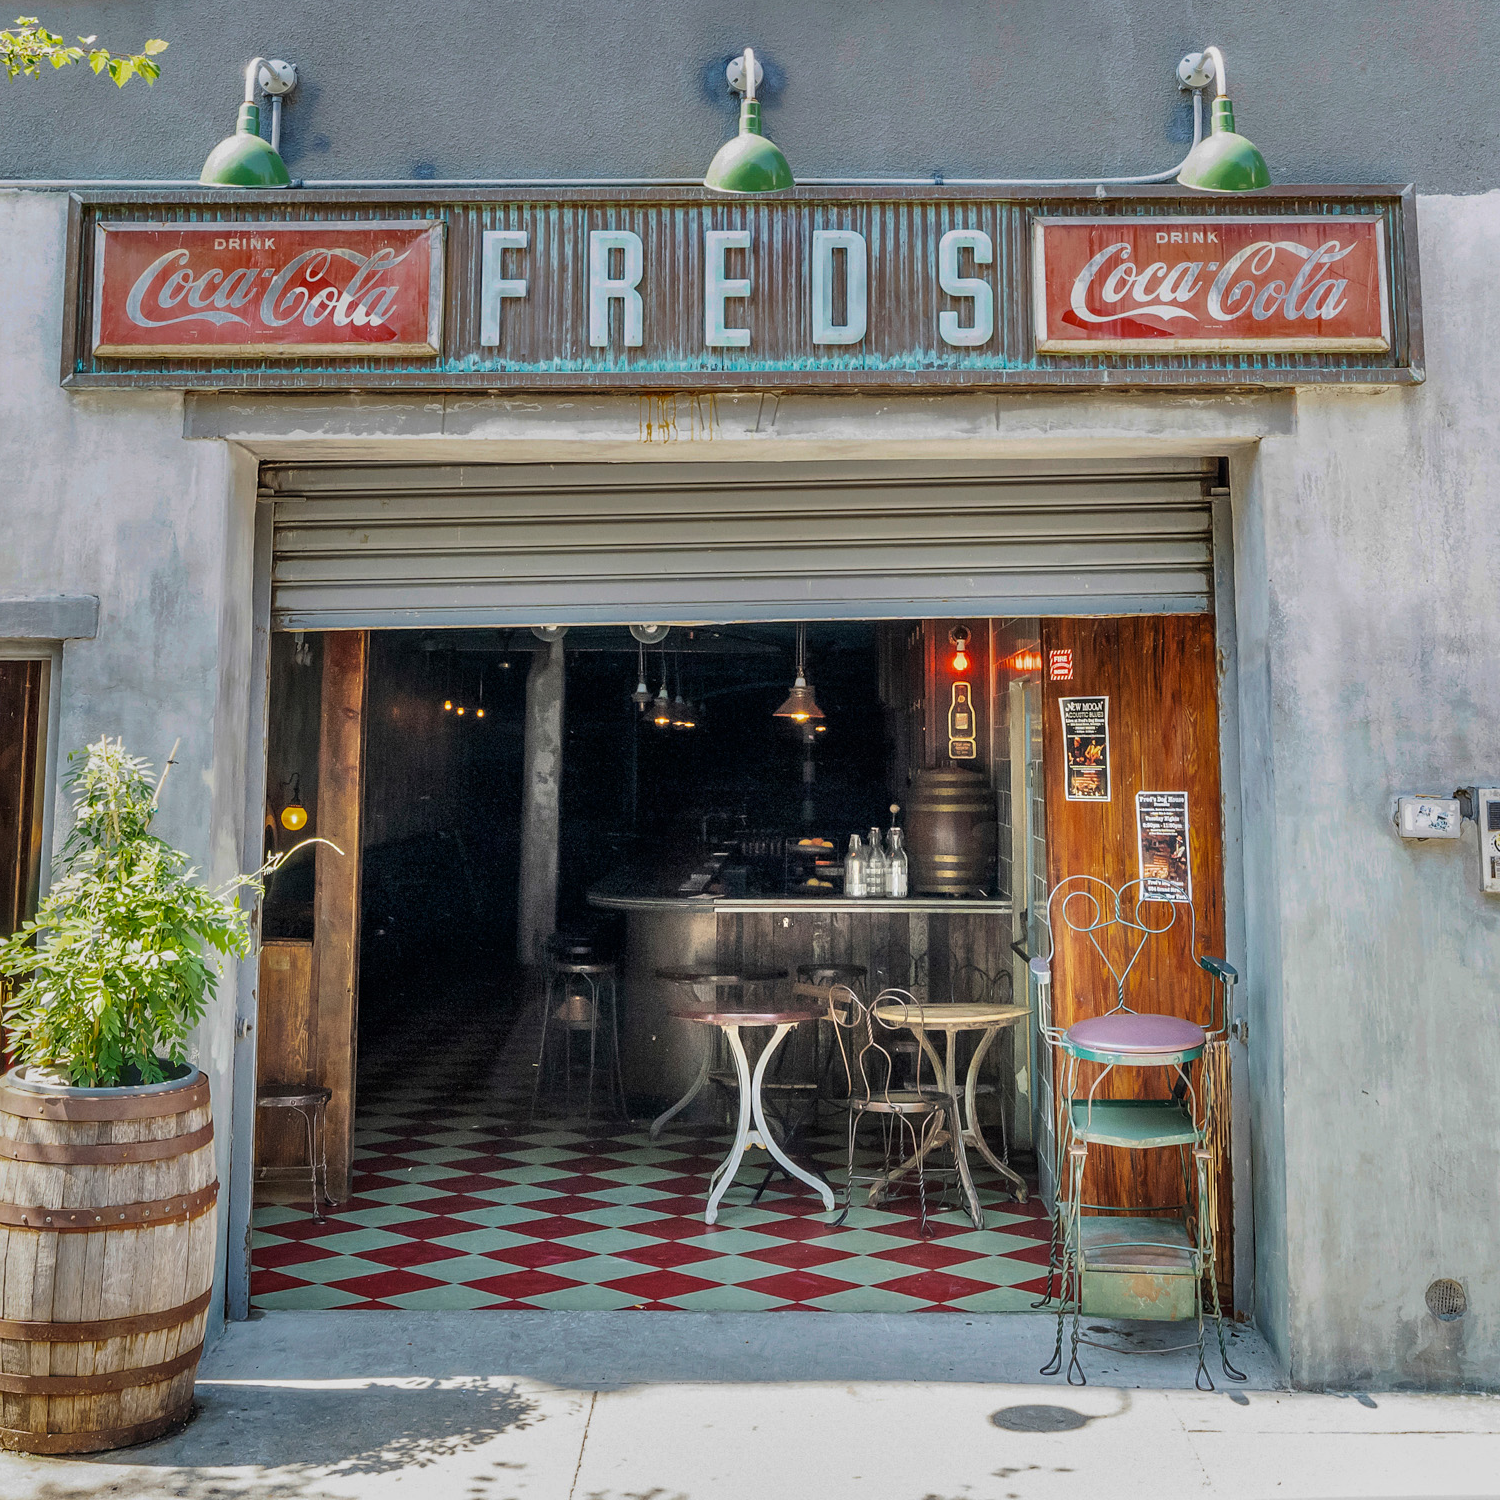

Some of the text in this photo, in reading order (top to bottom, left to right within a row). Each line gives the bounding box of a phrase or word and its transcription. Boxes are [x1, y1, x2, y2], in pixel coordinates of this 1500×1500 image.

[213, 237, 276, 251] DRINK
[1155, 231, 1219, 244] DRINK
[125, 247, 413, 328] Coca-Cola
[481, 229, 994, 348] FREDS
[1070, 240, 1359, 324] Coca-Cola
